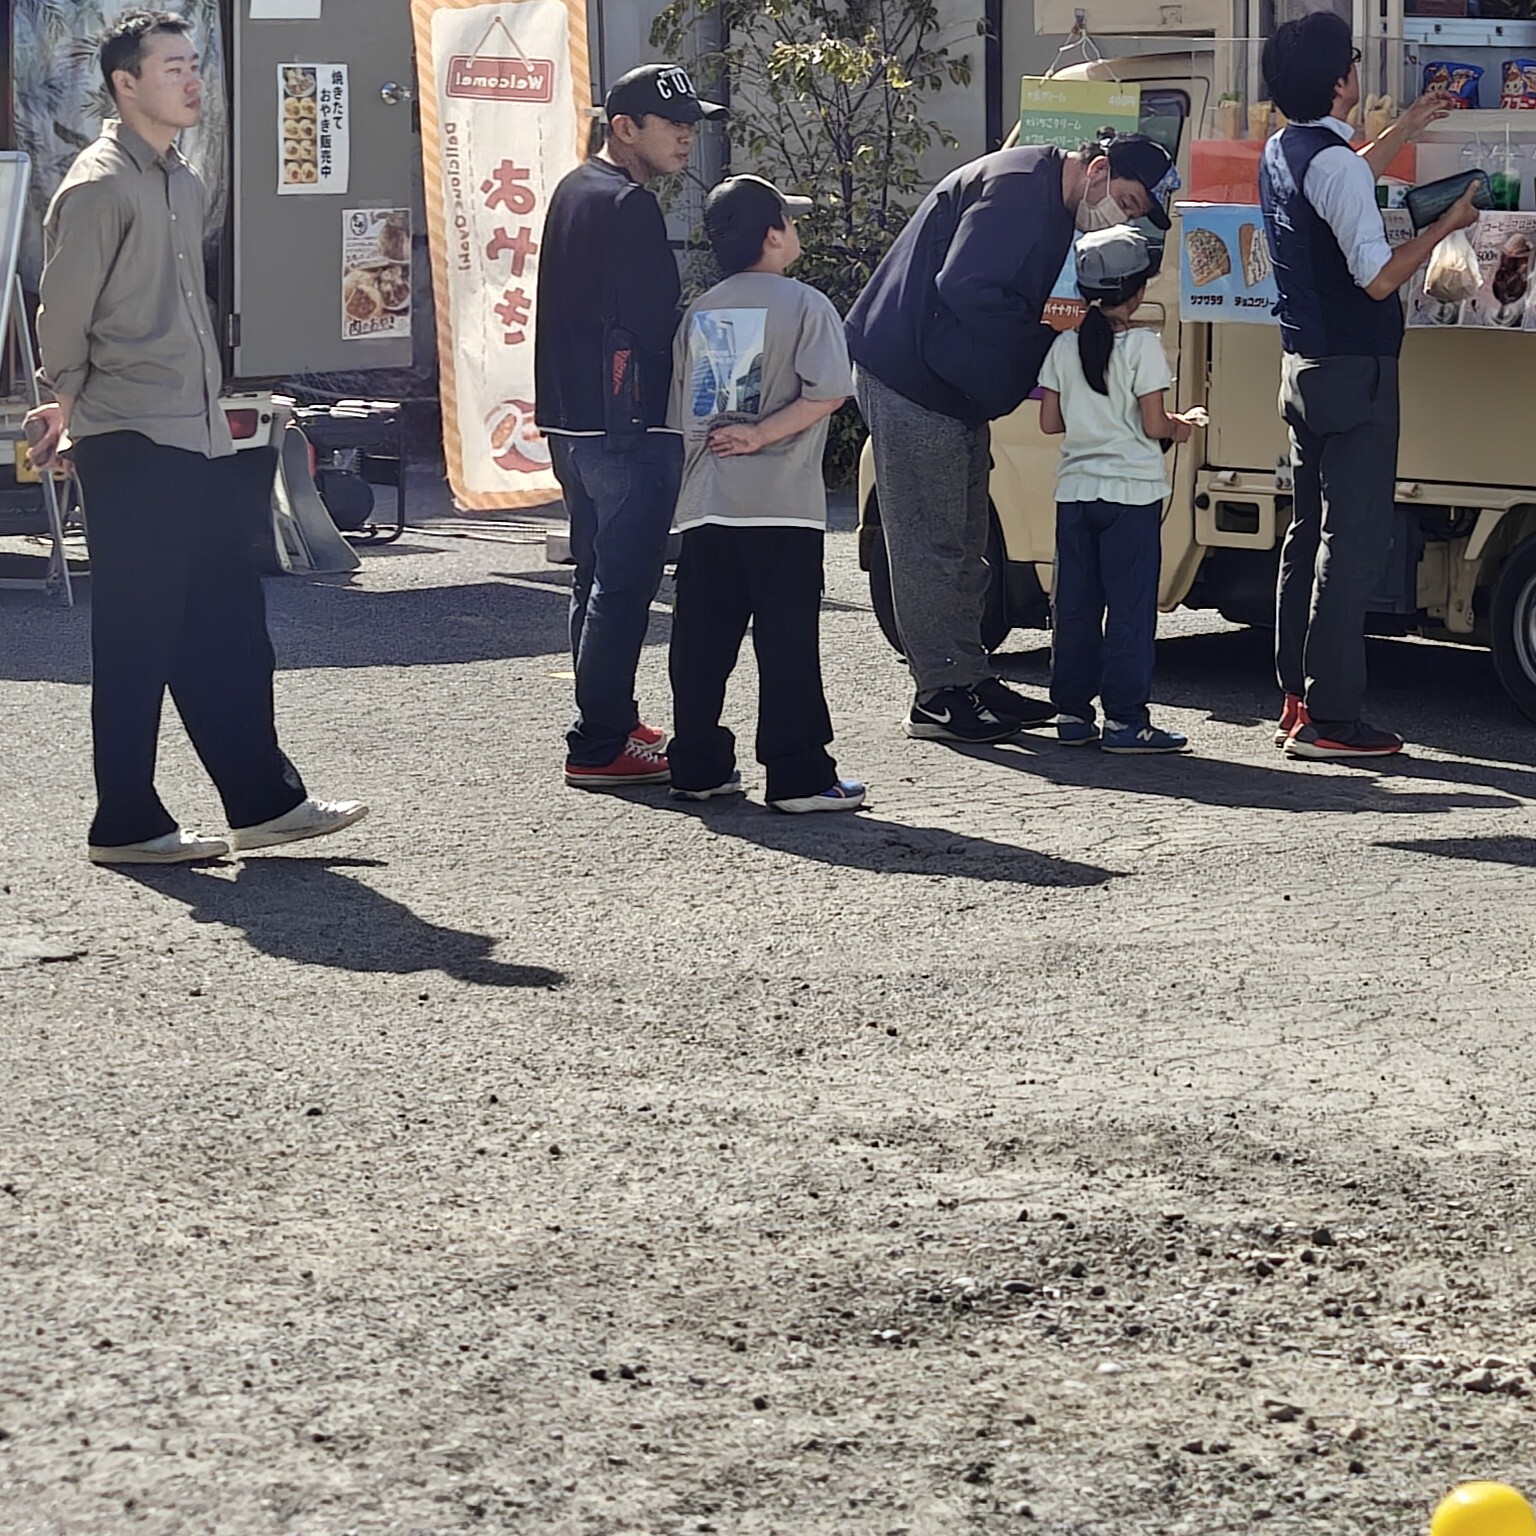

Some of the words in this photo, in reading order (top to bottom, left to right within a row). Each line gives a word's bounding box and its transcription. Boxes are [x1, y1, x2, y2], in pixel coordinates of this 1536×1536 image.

[331, 69, 344, 131] 焼きたて
[1043, 302, 1087, 317] バナナクリー
[1234, 296, 1276, 308] チョコクリー
